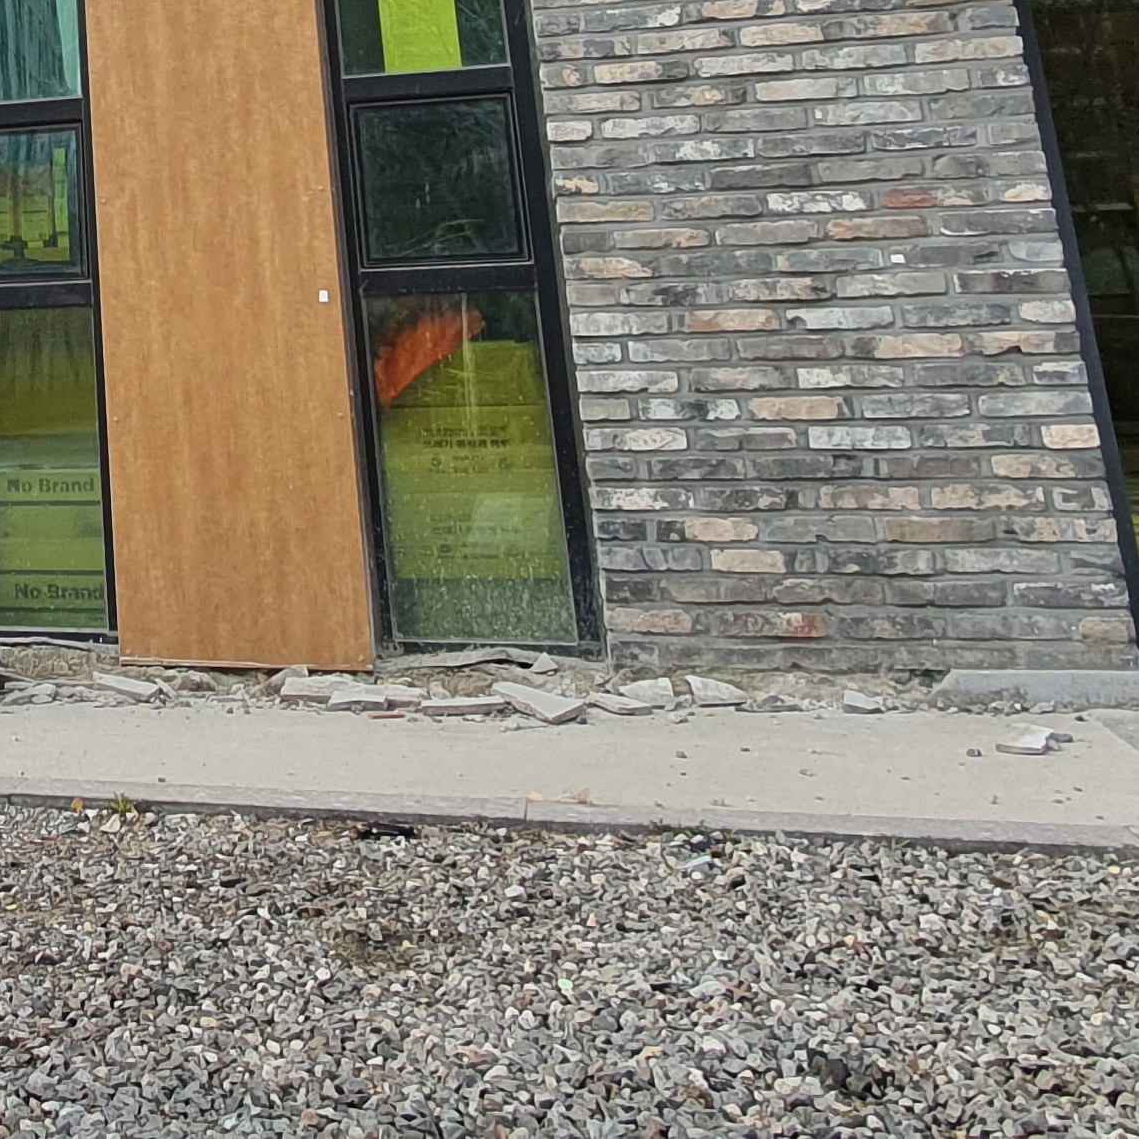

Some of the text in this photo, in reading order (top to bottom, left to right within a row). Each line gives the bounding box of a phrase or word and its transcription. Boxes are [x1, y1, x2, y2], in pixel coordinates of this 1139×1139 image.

[7, 476, 96, 494] No Brand
[14, 582, 105, 601] No Brand
